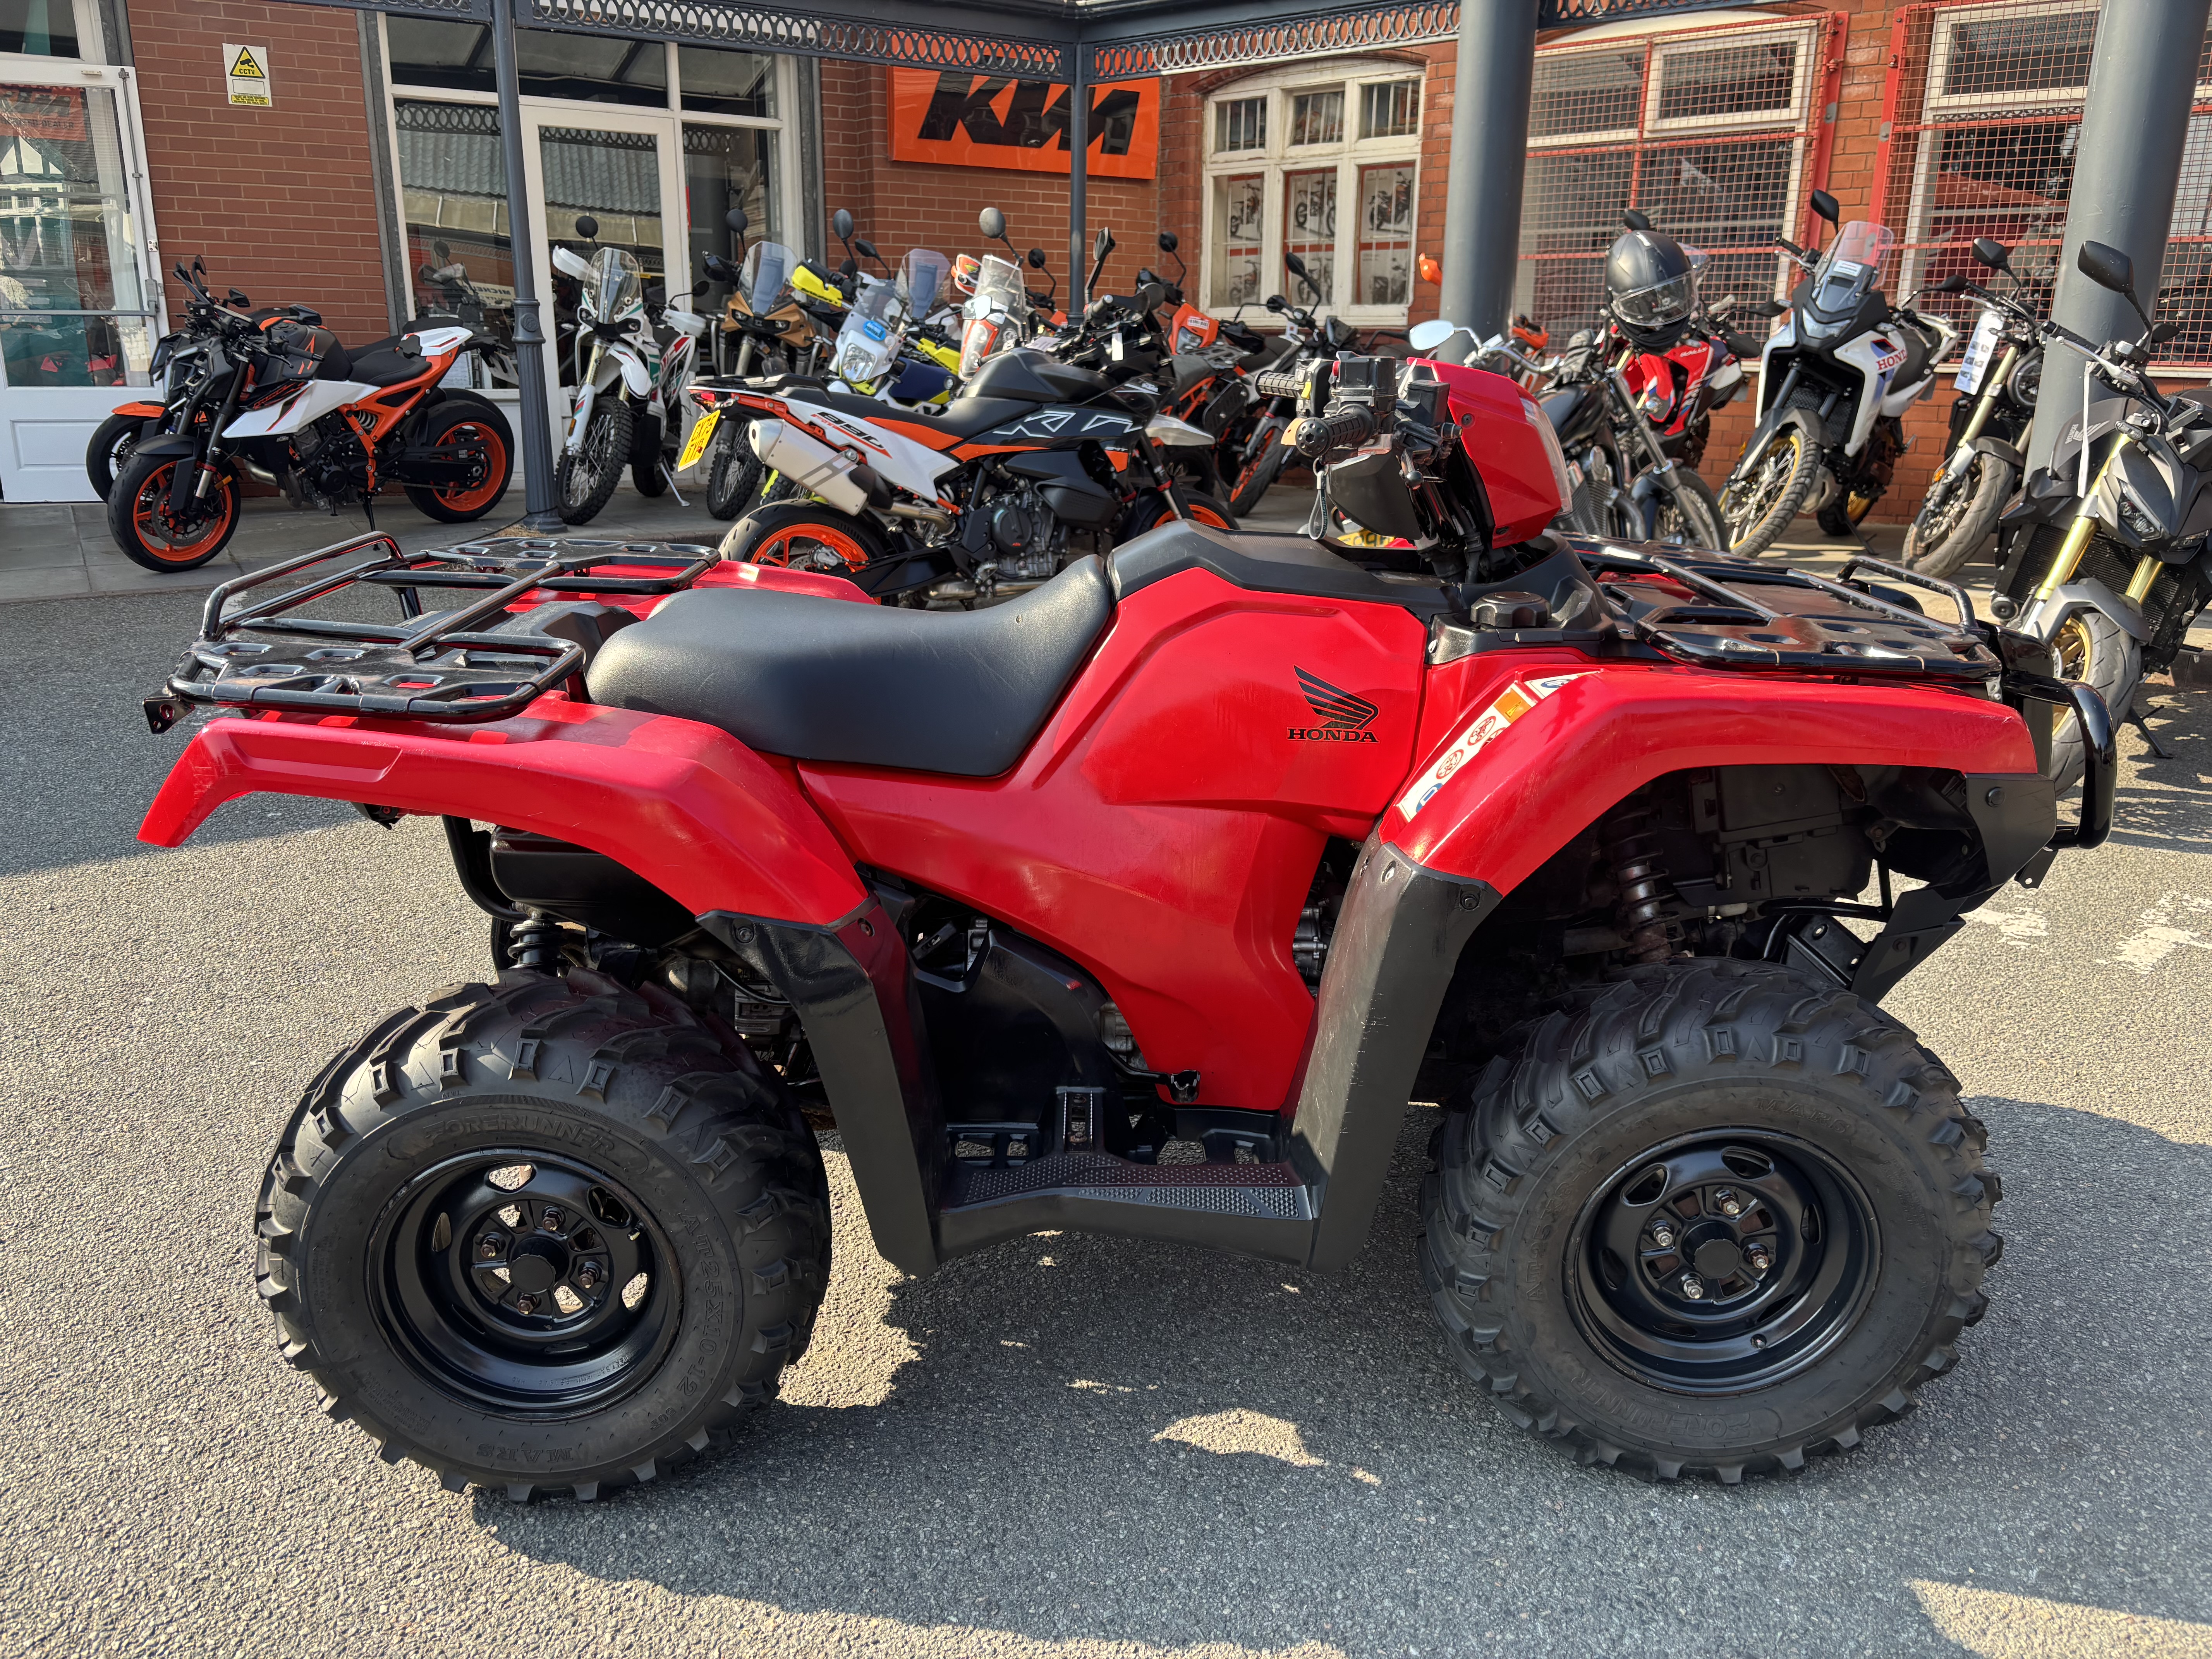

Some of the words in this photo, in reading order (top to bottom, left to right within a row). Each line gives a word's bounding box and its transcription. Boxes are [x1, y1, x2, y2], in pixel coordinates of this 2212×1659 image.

[917, 71, 1140, 155] KTM
[1876, 347, 1908, 371] HOND
[1288, 728, 1379, 743] HONDA
[1753, 1097, 1851, 1133] MARS
[476, 1442, 574, 1463] MARS
